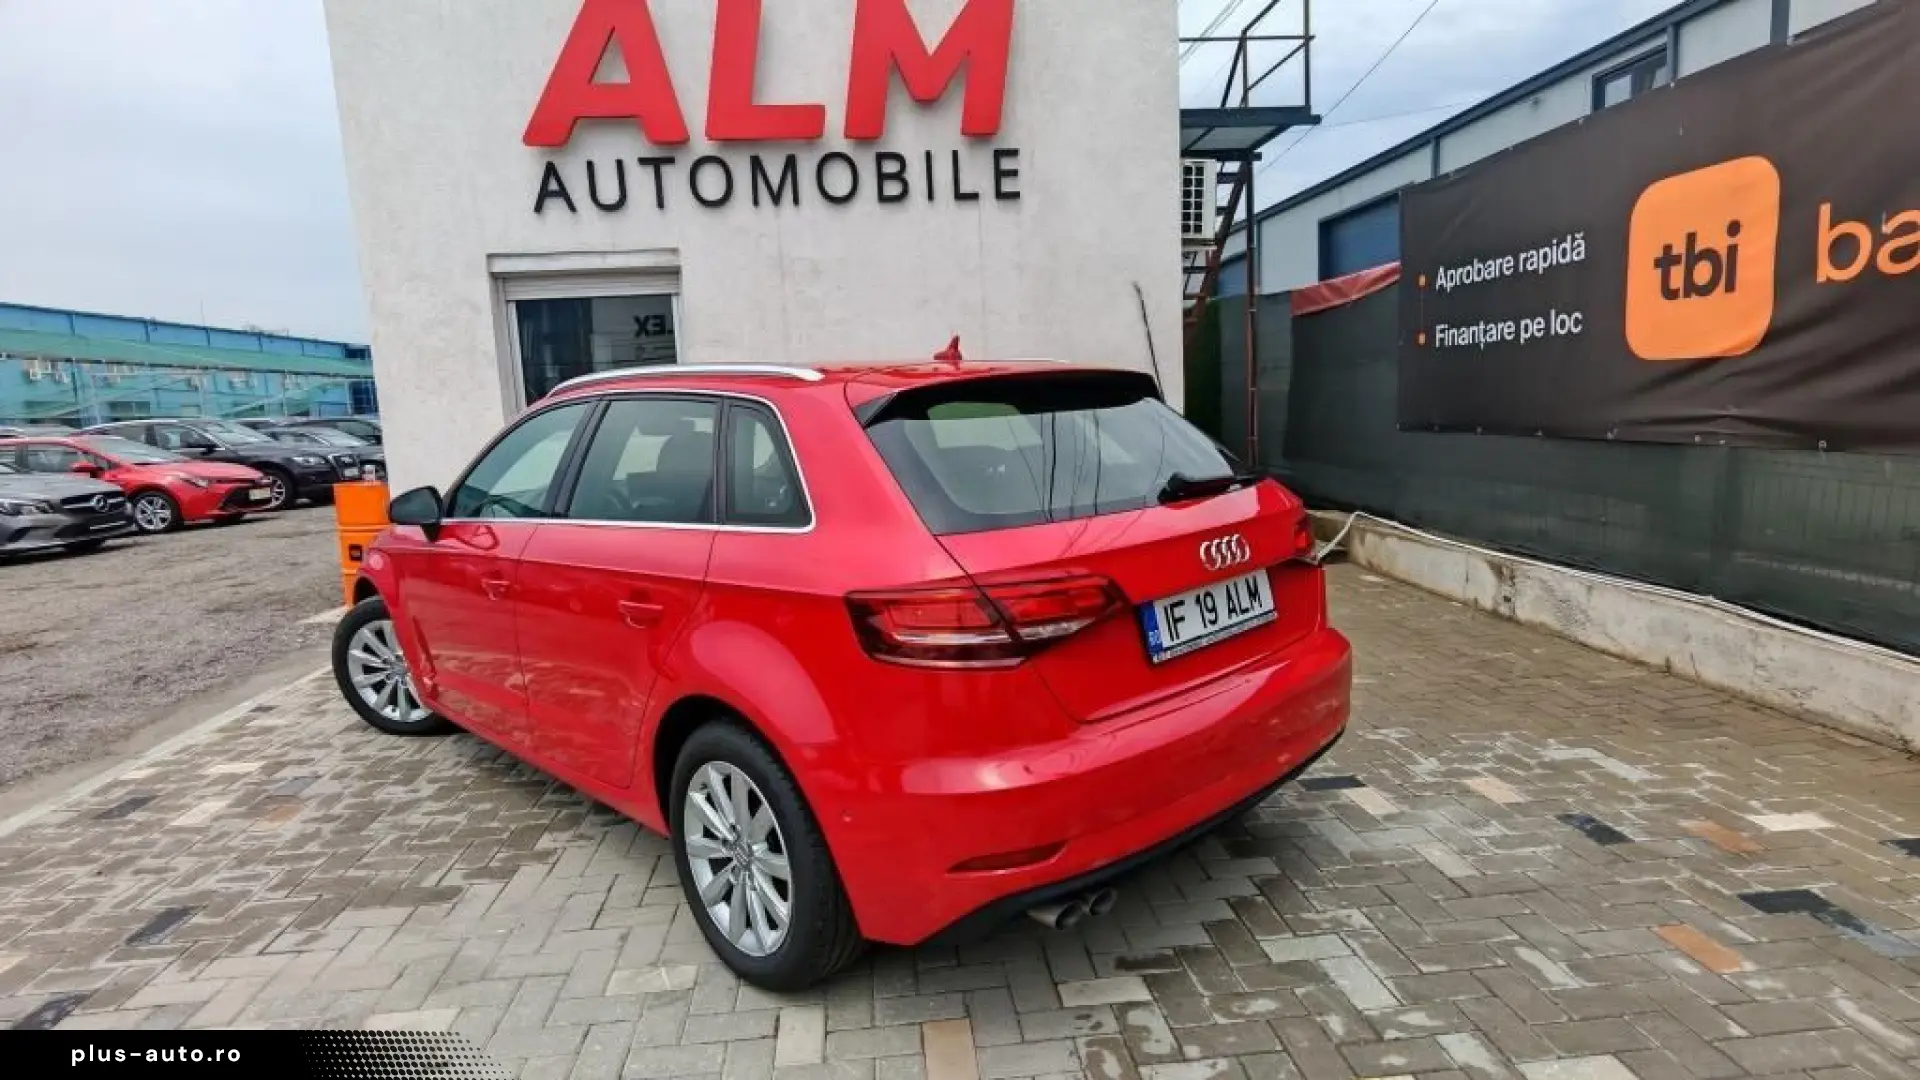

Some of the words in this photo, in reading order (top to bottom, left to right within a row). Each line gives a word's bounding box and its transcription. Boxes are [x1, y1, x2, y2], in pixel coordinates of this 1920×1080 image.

[522, 0, 1015, 147] ALM
[534, 147, 1021, 214] AUTOMOBILE
[1435, 256, 1515, 293] Aprobare
[1519, 231, 1586, 279] rapidă
[1654, 219, 1742, 301] tbi
[1435, 318, 1515, 350] Finanțare
[1520, 318, 1546, 343] pe
[1550, 309, 1584, 336] loc
[1163, 599, 1186, 642] IF
[1196, 590, 1219, 629] 19
[1225, 575, 1263, 620] ALM
